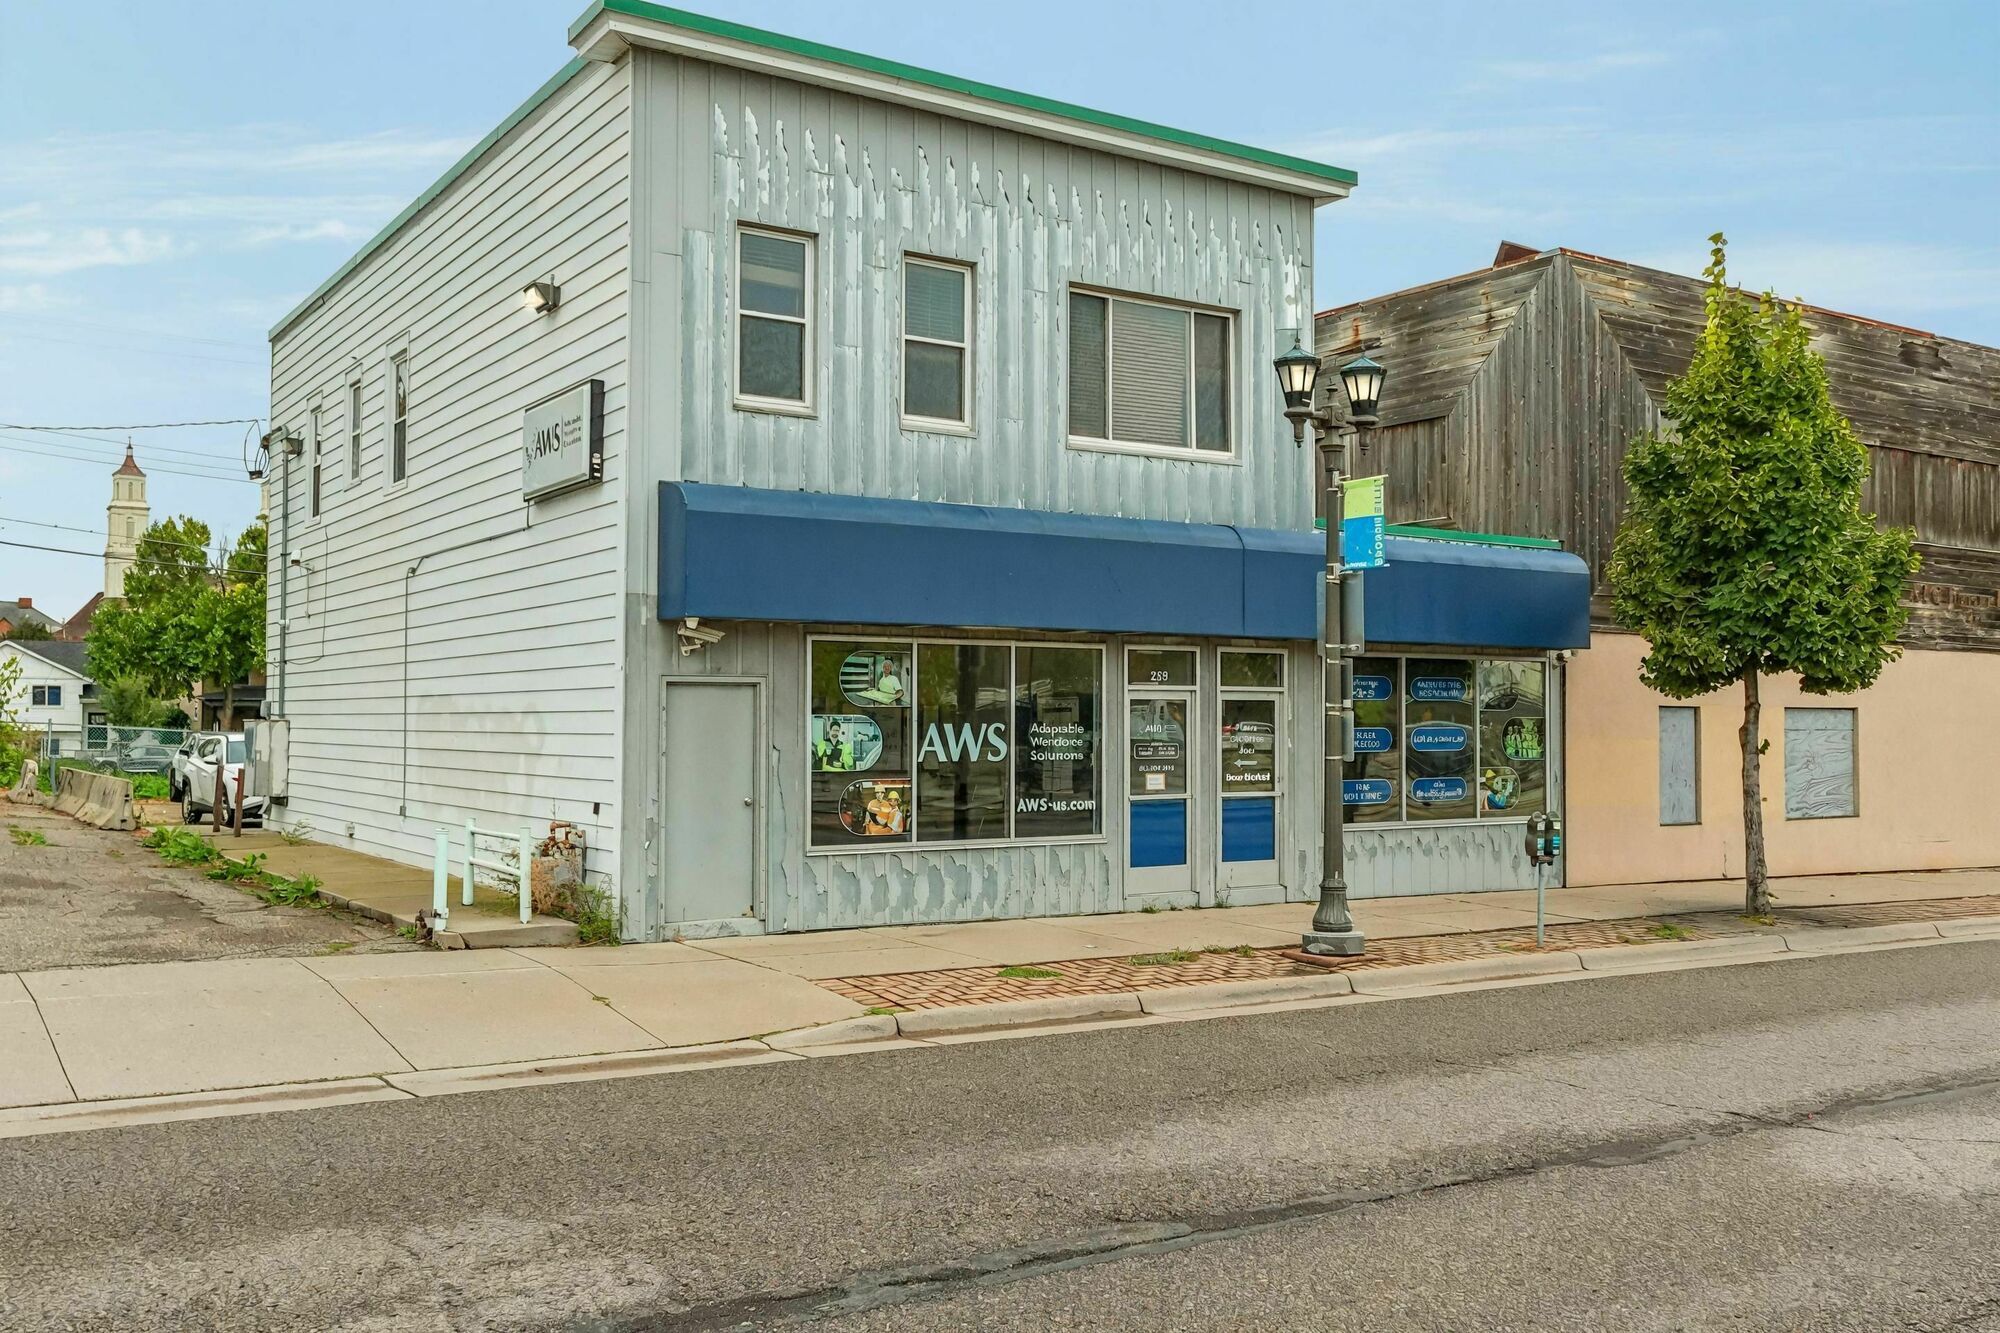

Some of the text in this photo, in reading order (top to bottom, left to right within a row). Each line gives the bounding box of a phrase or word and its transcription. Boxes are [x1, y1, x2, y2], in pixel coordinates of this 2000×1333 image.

[534, 423, 560, 460] AWS
[917, 722, 1008, 762] AWS
[1016, 797, 1096, 813] AWS-us.com
